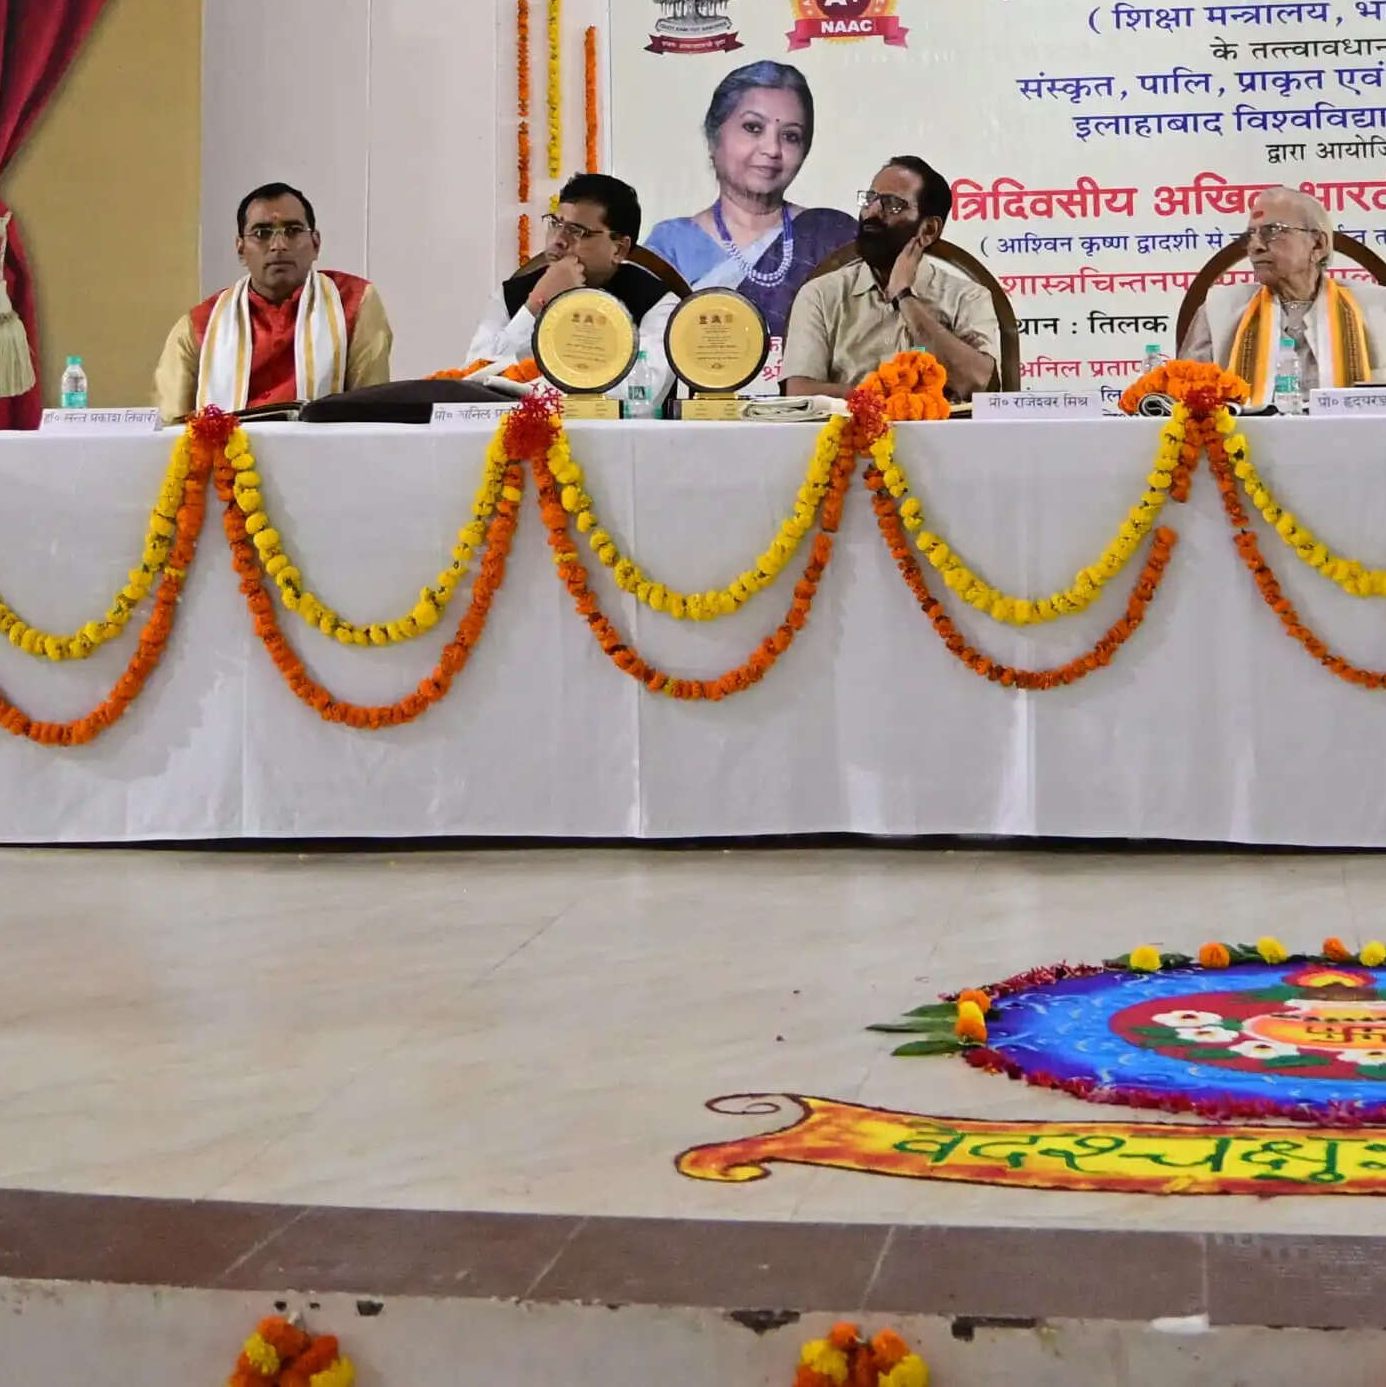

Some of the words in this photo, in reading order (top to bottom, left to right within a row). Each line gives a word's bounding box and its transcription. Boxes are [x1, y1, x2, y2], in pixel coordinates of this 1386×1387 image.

[821, 19, 873, 33] NAAC
[1210, 36, 1239, 60] के
[1234, 69, 1326, 98] प्राकृत
[1333, 60, 1386, 97] एवं
[1073, 112, 1224, 143] इलाहाबाद
[1265, 143, 1307, 165] द्वारा
[951, 176, 1139, 222] त्रिदिवसीय
[1079, 236, 1129, 260] कृष्ण
[1134, 228, 1199, 256] द्वादशी
[1204, 226, 1225, 250] से
[1087, 310, 1169, 334] तिलक
[1020, 355, 1081, 378] अनिल
